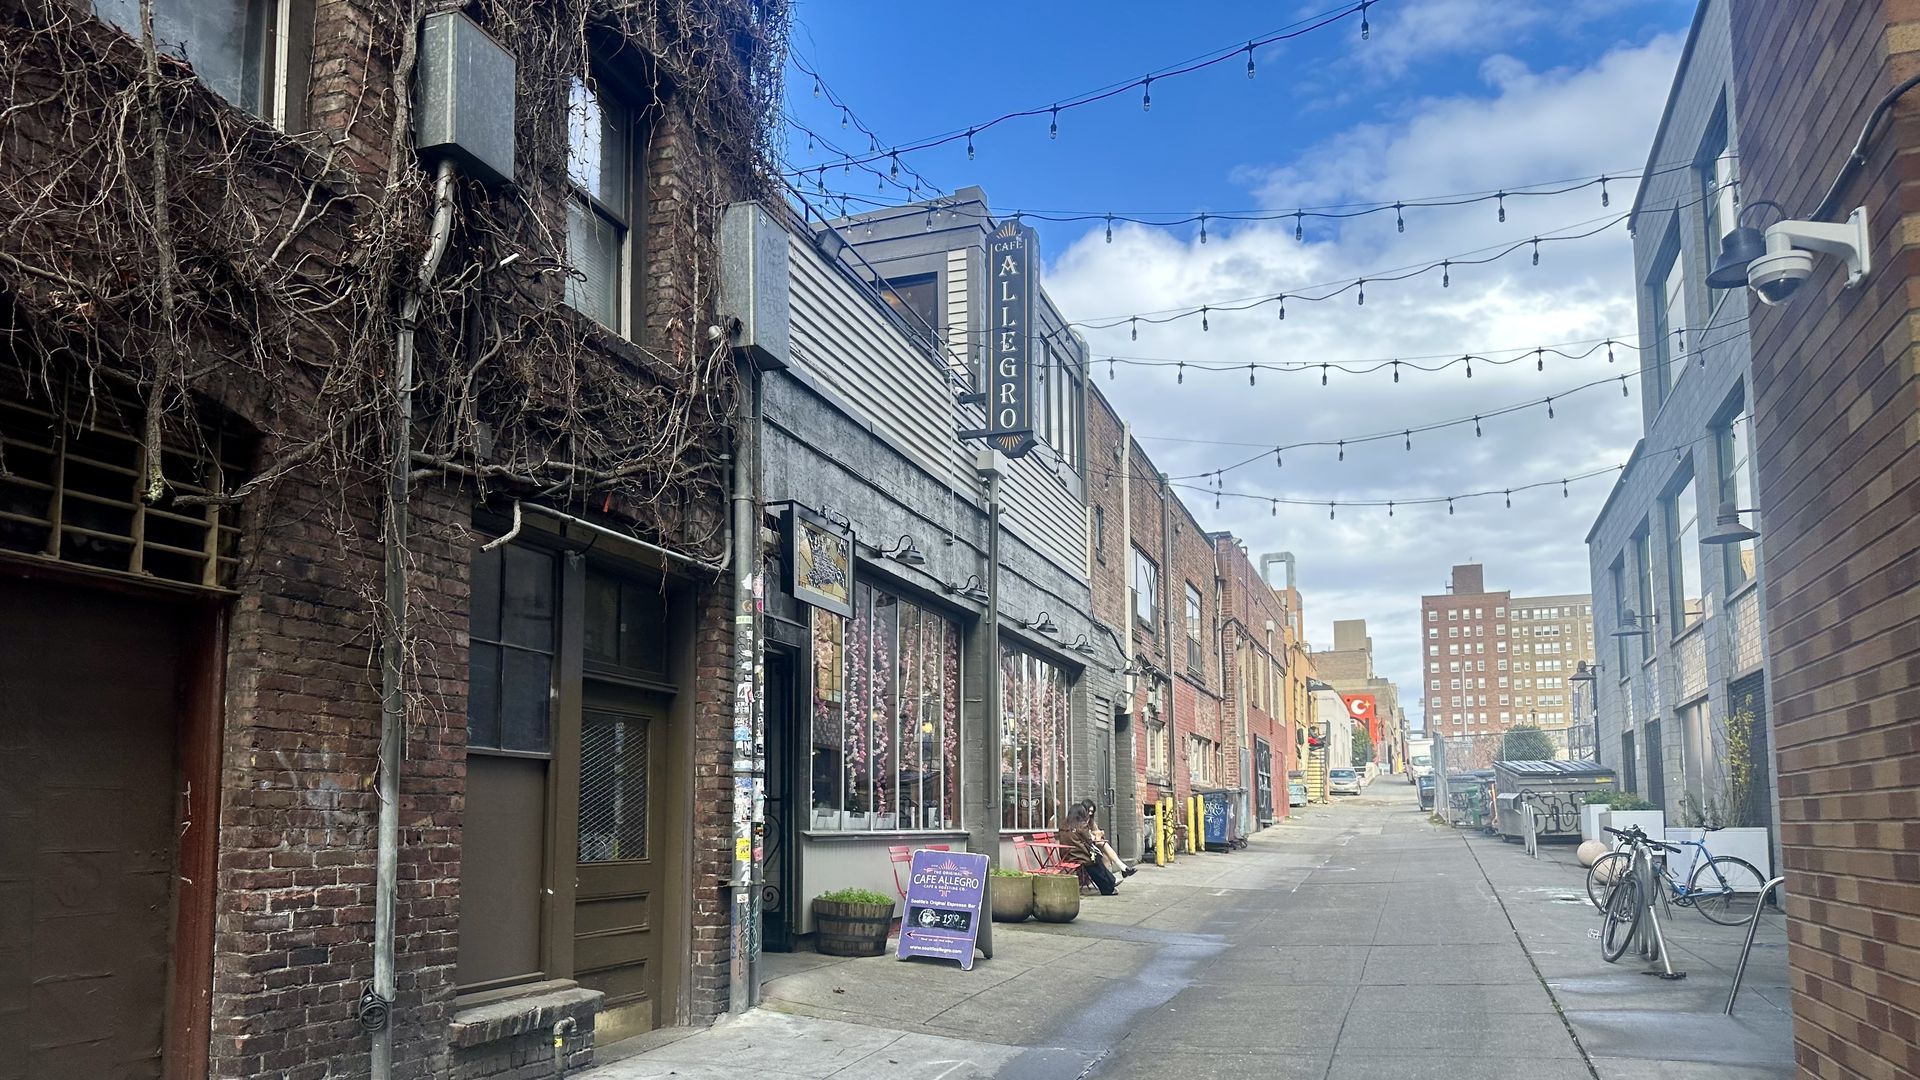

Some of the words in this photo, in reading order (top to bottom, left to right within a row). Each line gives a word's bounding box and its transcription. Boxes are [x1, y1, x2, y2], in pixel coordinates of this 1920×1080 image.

[999, 255, 1018, 429] ALLEGRO
[913, 874, 937, 884] CAFE
[938, 876, 979, 889] ALLEGRO
